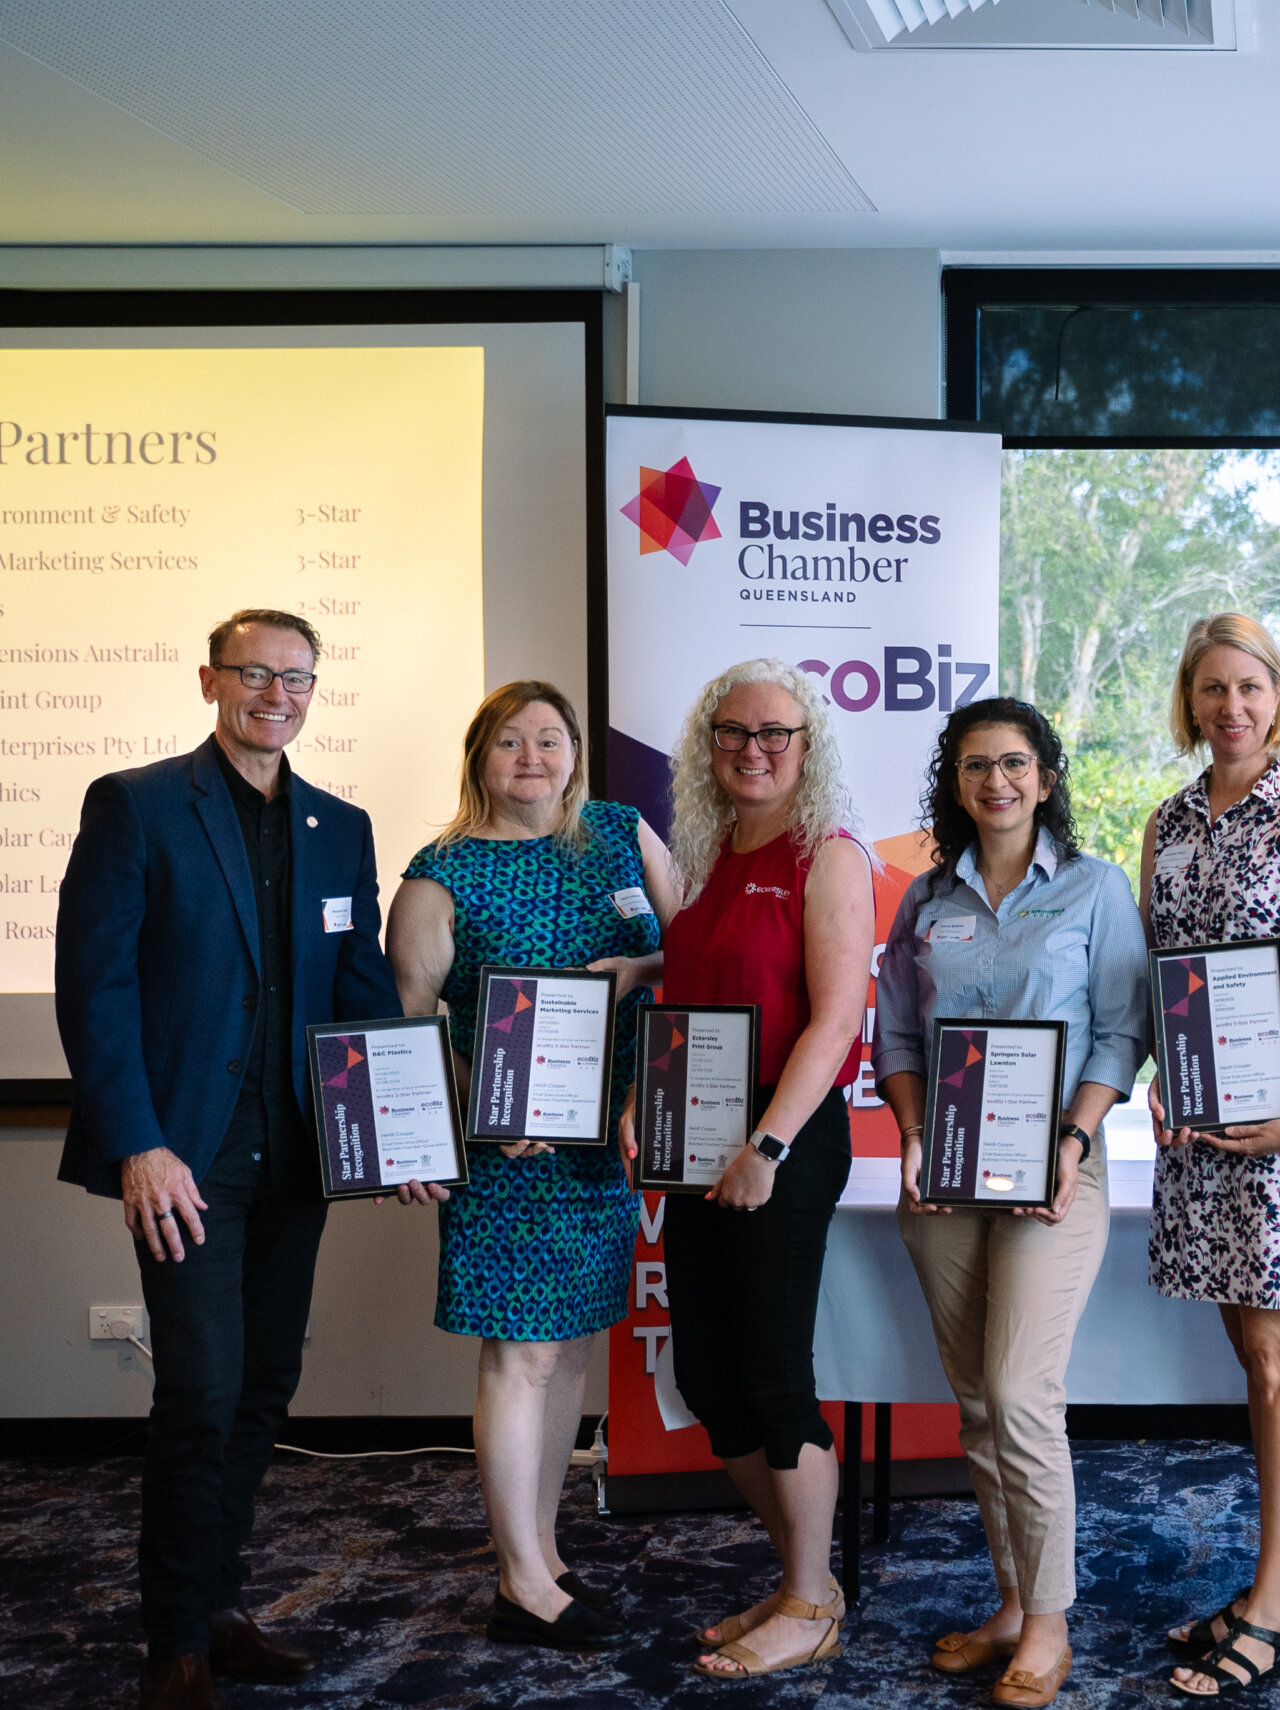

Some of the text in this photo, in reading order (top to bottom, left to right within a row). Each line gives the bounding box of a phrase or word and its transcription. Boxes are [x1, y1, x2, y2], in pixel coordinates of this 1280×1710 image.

[0, 421, 217, 465] Partners
[0, 504, 191, 527] ronment & Safety
[296, 504, 362, 526] 3-Star
[739, 501, 942, 545] Business
[110, 550, 198, 571] Services
[296, 550, 361, 573] 3-Star
[738, 543, 909, 583] Chamber
[296, 597, 361, 616] 2-Star
[739, 588, 857, 603] QUEENSLAND
[84, 642, 179, 663] Australia
[320, 643, 361, 661] Star
[35, 690, 102, 713] Group
[316, 688, 360, 707] Star
[104, 736, 136, 759] Pty
[143, 735, 177, 755] Ltd
[295, 734, 358, 753] 1-Star
[1212, 969, 1277, 982] Applied Environment
[539, 1007, 572, 1015] Marketing
[488, 1047, 506, 1125] Star Partnership
[1175, 1033, 1191, 1116] Star Partnership
[1189, 1054, 1203, 1114] Recognition
[500, 1069, 514, 1125] Recognition
[652, 1087, 664, 1170] Star Partnership
[662, 1111, 672, 1170] Recognition
[334, 1103, 351, 1180] Star Partnership
[349, 1122, 364, 1179] Recognition
[940, 1104, 957, 1187] Star Partnership
[951, 1127, 965, 1187] Recognition
